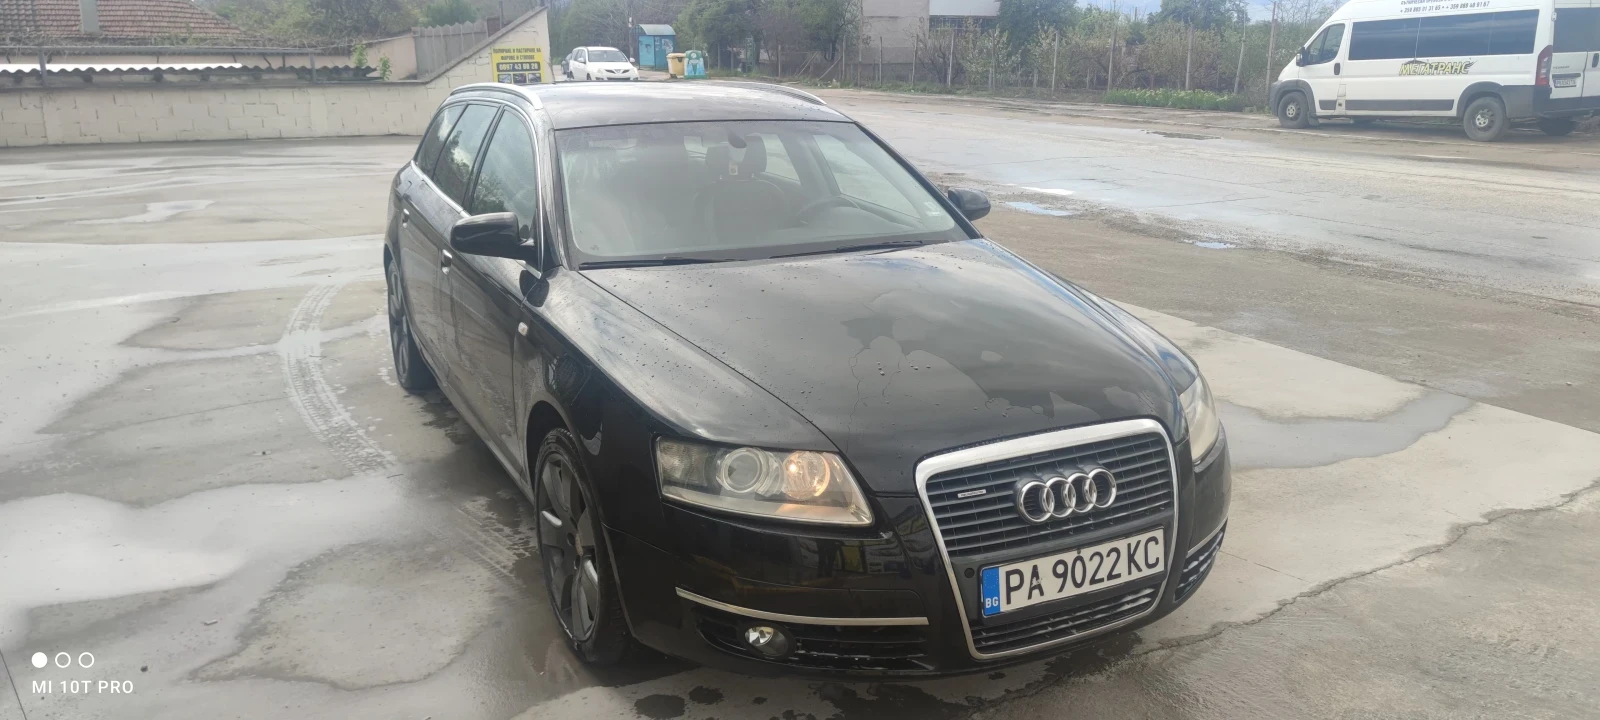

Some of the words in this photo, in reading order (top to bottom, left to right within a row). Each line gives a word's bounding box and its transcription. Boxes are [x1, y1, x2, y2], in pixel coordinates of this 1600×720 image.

[1399, 61, 1471, 76] МЕГАТРАНС
[1005, 565, 1045, 605] PA
[1052, 547, 1121, 593] 9022
[1127, 536, 1160, 575] KC
[985, 597, 999, 609] BG
